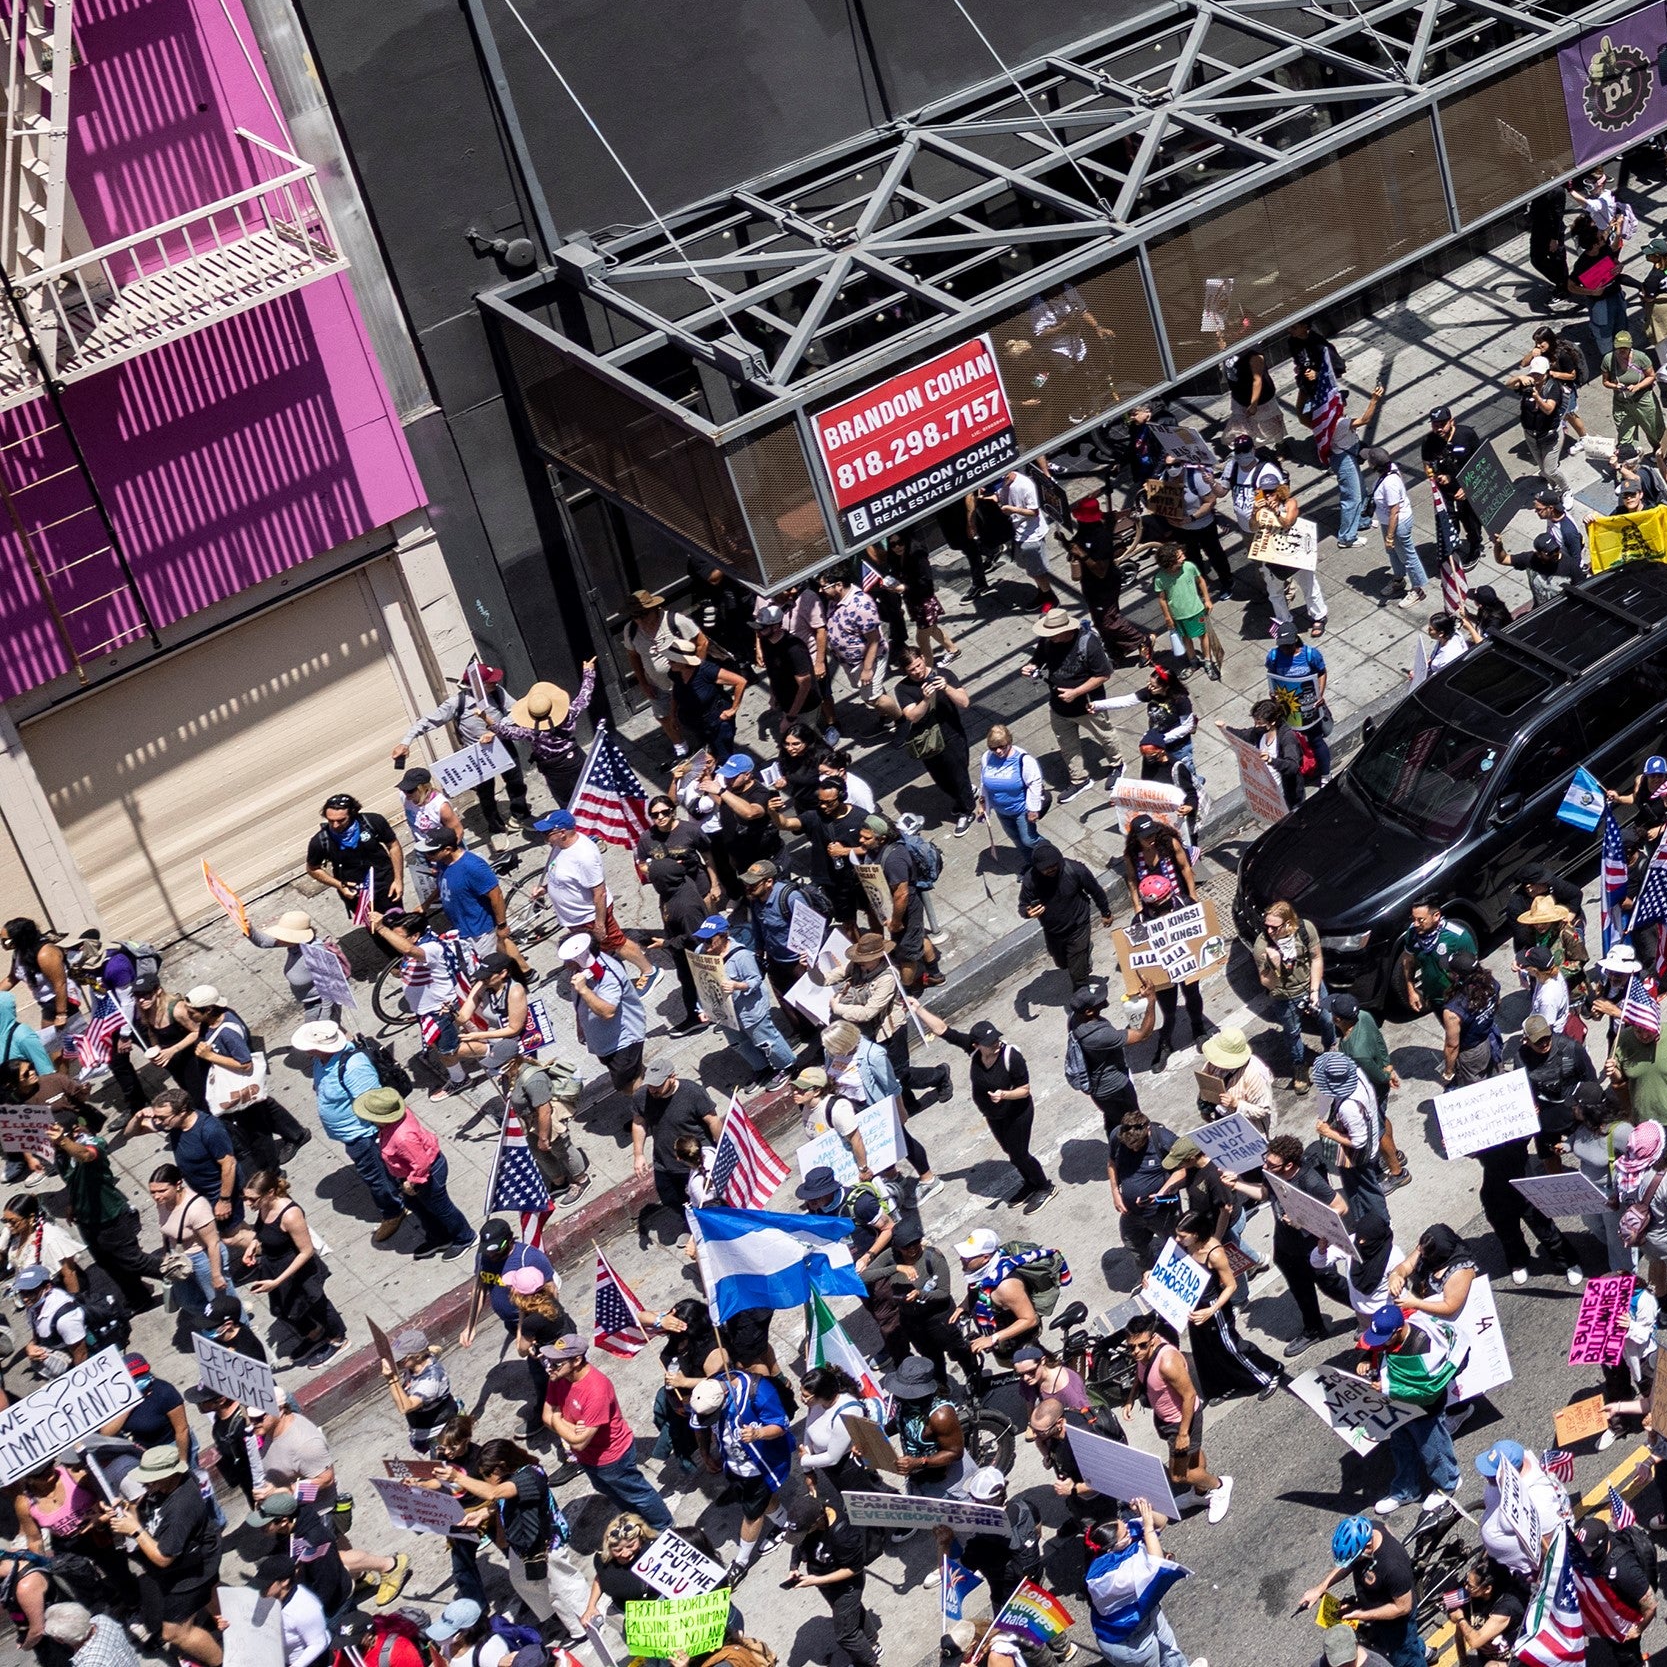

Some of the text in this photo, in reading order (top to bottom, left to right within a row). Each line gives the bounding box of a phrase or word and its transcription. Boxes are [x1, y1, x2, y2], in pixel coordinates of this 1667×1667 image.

[1602, 72, 1633, 114] pf
[824, 353, 993, 452] BRANDON COHAN
[836, 390, 1000, 489] 818.298.7157
[870, 434, 1012, 514] BRANDON COHAN
[875, 449, 1014, 526] REAL ESTATE BCRE.LA
[1151, 909, 1201, 935] NO KINGS!
[1169, 925, 1204, 944] KINGS!
[1197, 1117, 1243, 1145] UNITY
[1152, 1261, 1200, 1308] DEMOCRACY
[69, 1354, 113, 1391] OUR
[199, 1344, 271, 1390] DEPORT
[203, 1369, 277, 1411] TRUMP
[0, 1374, 134, 1475] IMMIGRANTS
[850, 1508, 946, 1526] EVERYBODY
[662, 1531, 711, 1565] TRUMP
[1011, 1598, 1056, 1633] trumps
[1020, 1585, 1053, 1609] Love
[695, 1609, 728, 1627] HUMAN
[1001, 1610, 1030, 1629] hate.
